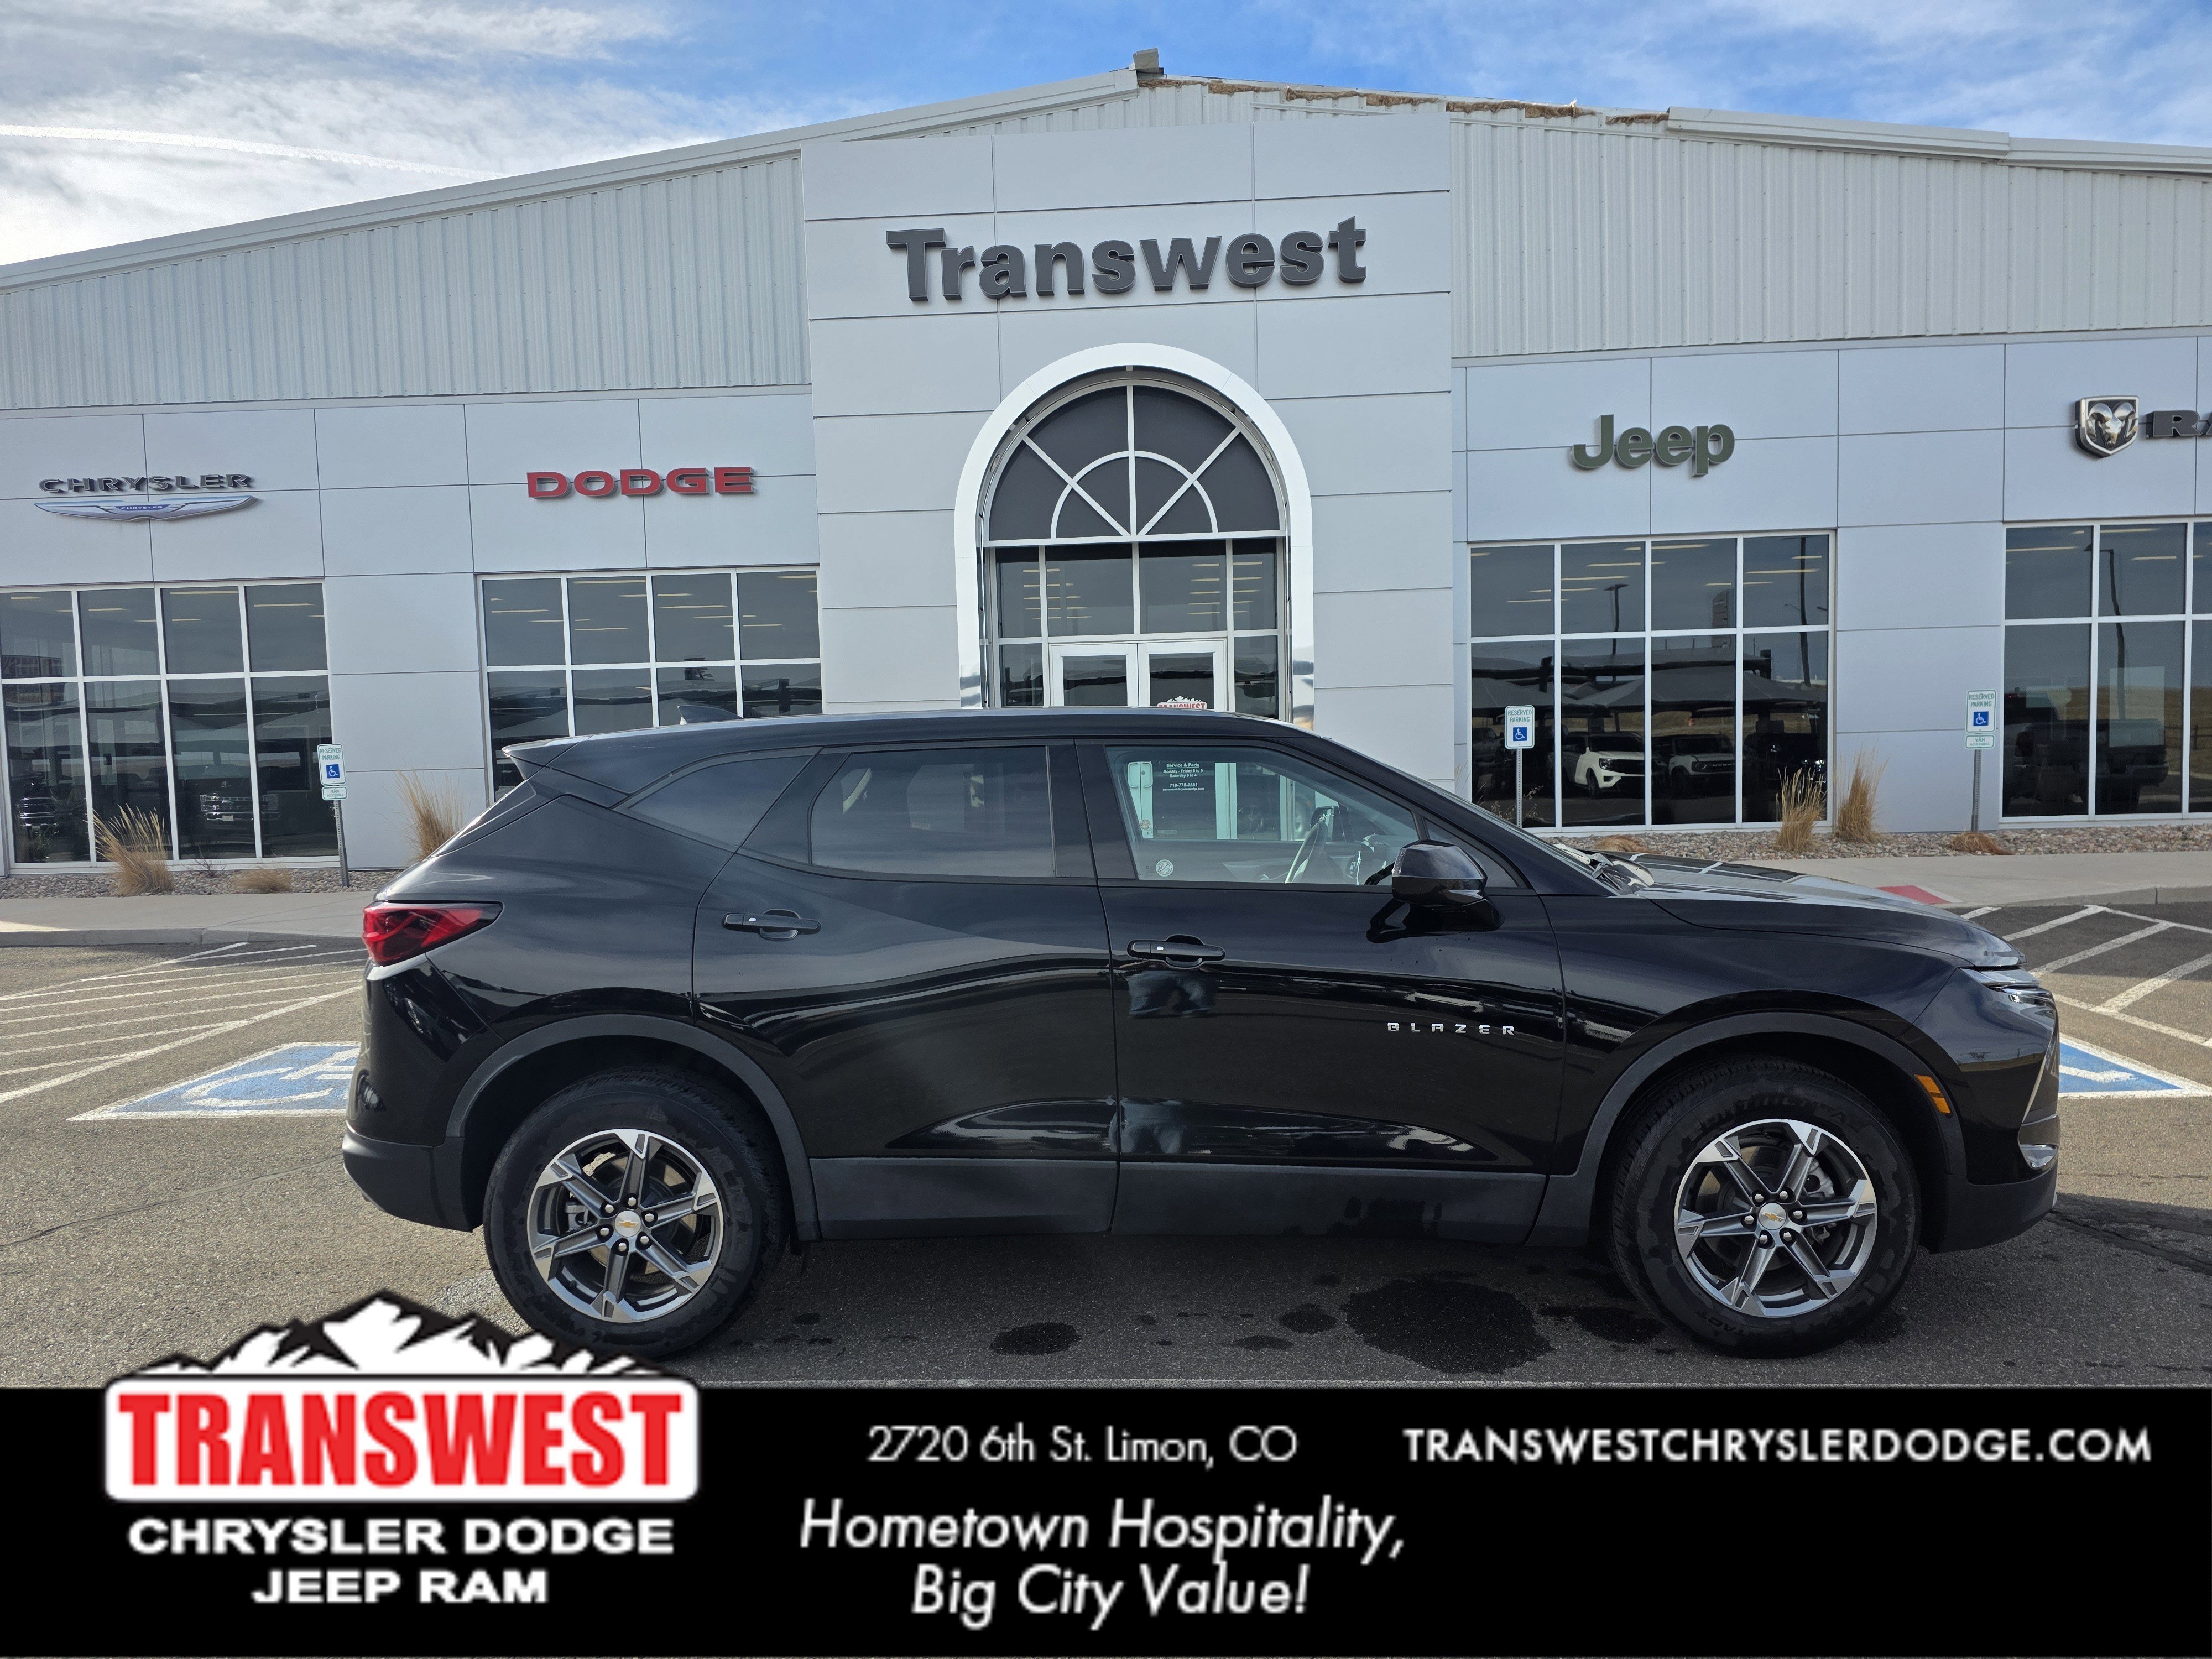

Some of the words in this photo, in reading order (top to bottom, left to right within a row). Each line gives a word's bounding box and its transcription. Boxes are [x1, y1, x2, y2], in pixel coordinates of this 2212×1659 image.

[886, 216, 1366, 301] Transwest
[2146, 410, 2212, 439] R
[1571, 414, 1735, 477] Jeep
[39, 473, 253, 494] CHRYSLER
[527, 467, 755, 498] DODGE
[1387, 1022, 1514, 1035] BLAZER
